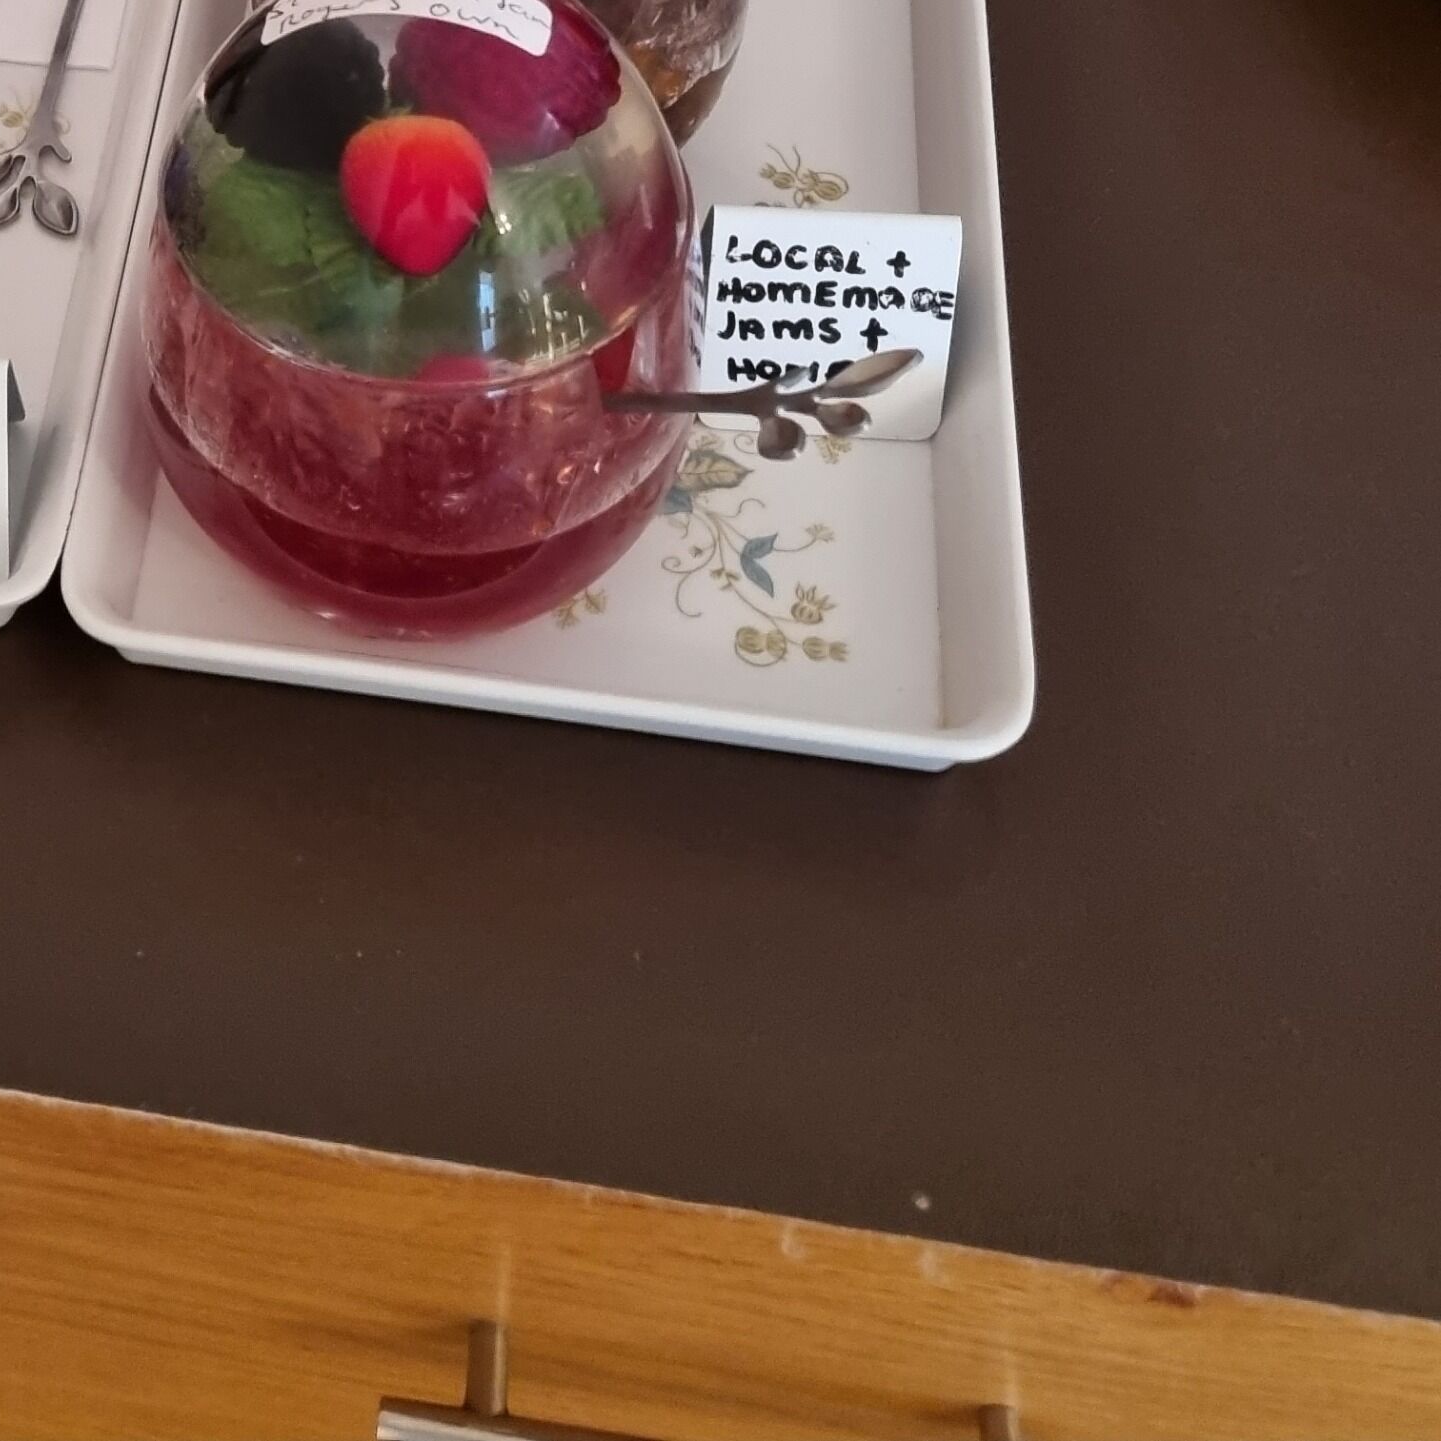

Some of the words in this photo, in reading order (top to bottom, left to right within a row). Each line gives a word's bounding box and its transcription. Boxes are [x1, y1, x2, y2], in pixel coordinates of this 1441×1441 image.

[725, 235, 866, 274] LOCAL
[886, 250, 911, 278] +
[717, 310, 842, 344] JAMS
[860, 317, 889, 352] +
